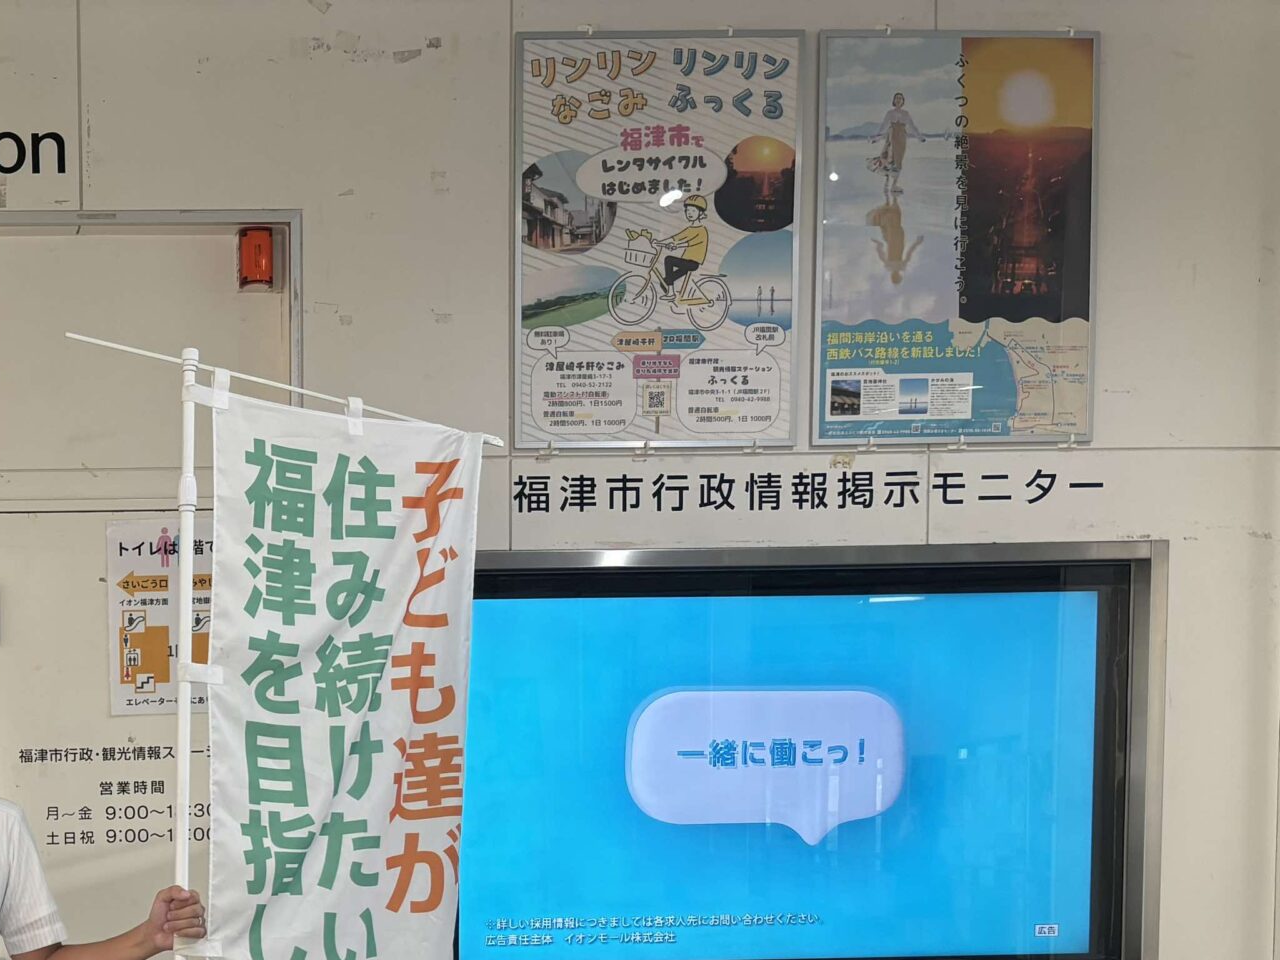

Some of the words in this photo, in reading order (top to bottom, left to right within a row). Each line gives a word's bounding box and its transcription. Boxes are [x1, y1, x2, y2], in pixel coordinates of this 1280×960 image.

[531, 49, 656, 87] リンリン
[672, 48, 789, 80] リンリン
[551, 87, 647, 124] なごみ
[668, 84, 783, 119] ふっくる
[620, 124, 705, 151] 福津市で
[601, 156, 706, 173] レンタサイクル
[827, 331, 933, 345] 福間海岸沿いを通る
[708, 375, 749, 386] ふっくる
[513, 469, 1105, 514] 福津市行政情報掲示モニター
[119, 598, 169, 606] イオン福津方面
[385, 457, 465, 914] 子ども達が
[99, 780, 165, 795] 営業時間
[46, 830, 95, 845] 土日祝
[485, 933, 553, 946] 広告責任主体
[564, 931, 676, 945] イオンモール株式会社
[1037, 926, 1056, 935] 広告
